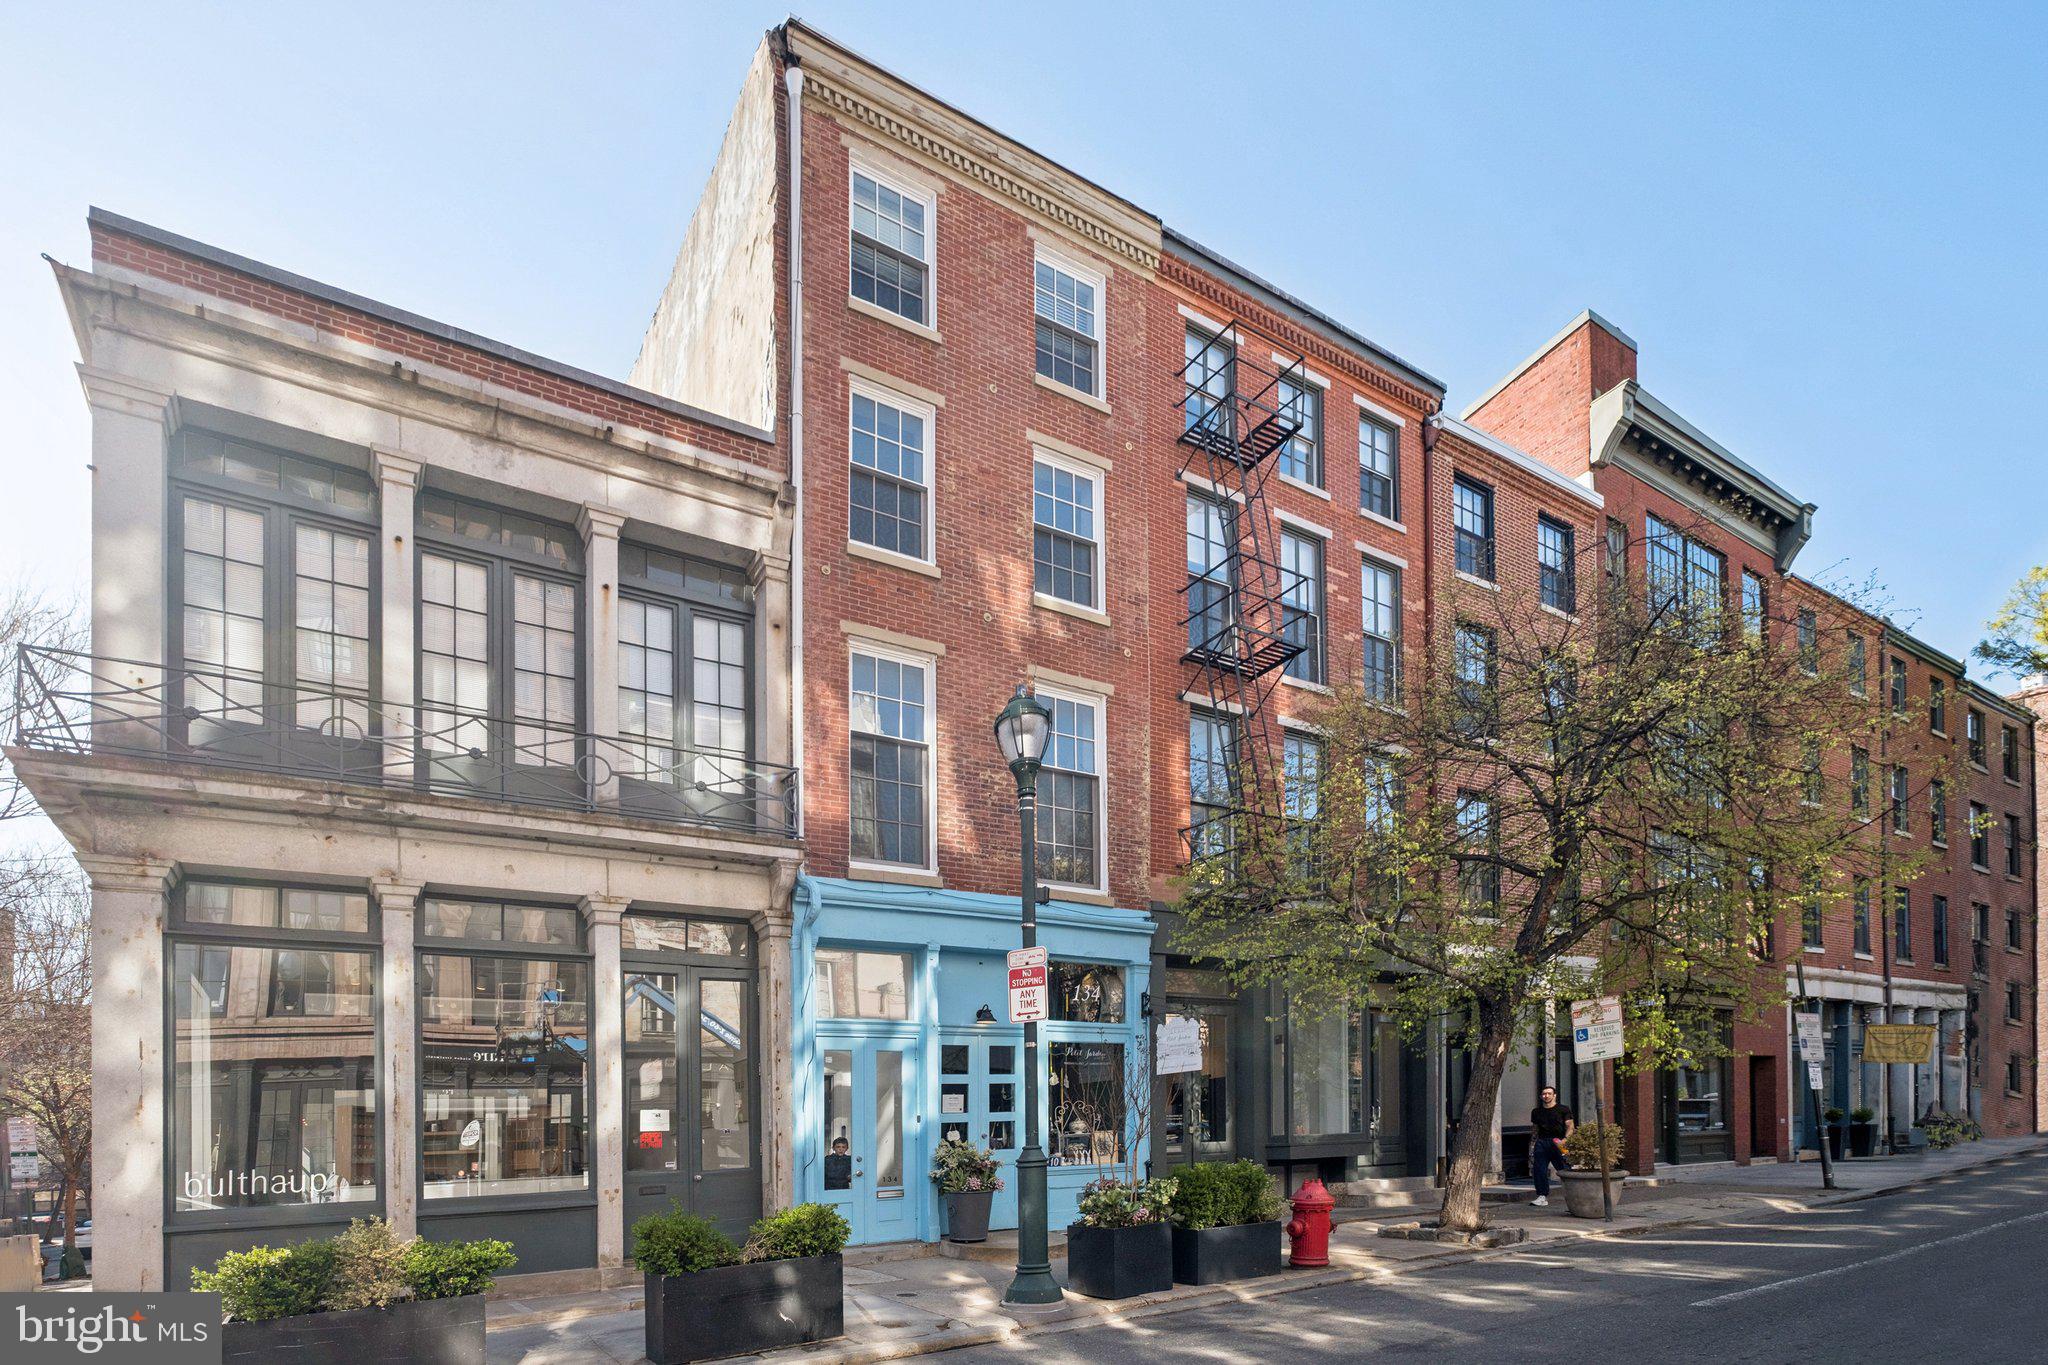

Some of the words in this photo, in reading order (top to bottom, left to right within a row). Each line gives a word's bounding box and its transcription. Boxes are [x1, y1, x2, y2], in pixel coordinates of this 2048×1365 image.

[1012, 977, 1043, 987] STOPPING
[1020, 989, 1036, 999] ANY
[1072, 984, 1100, 1001] 134
[1020, 999, 1037, 1009] TIME
[184, 1168, 327, 1203] bulthaup
